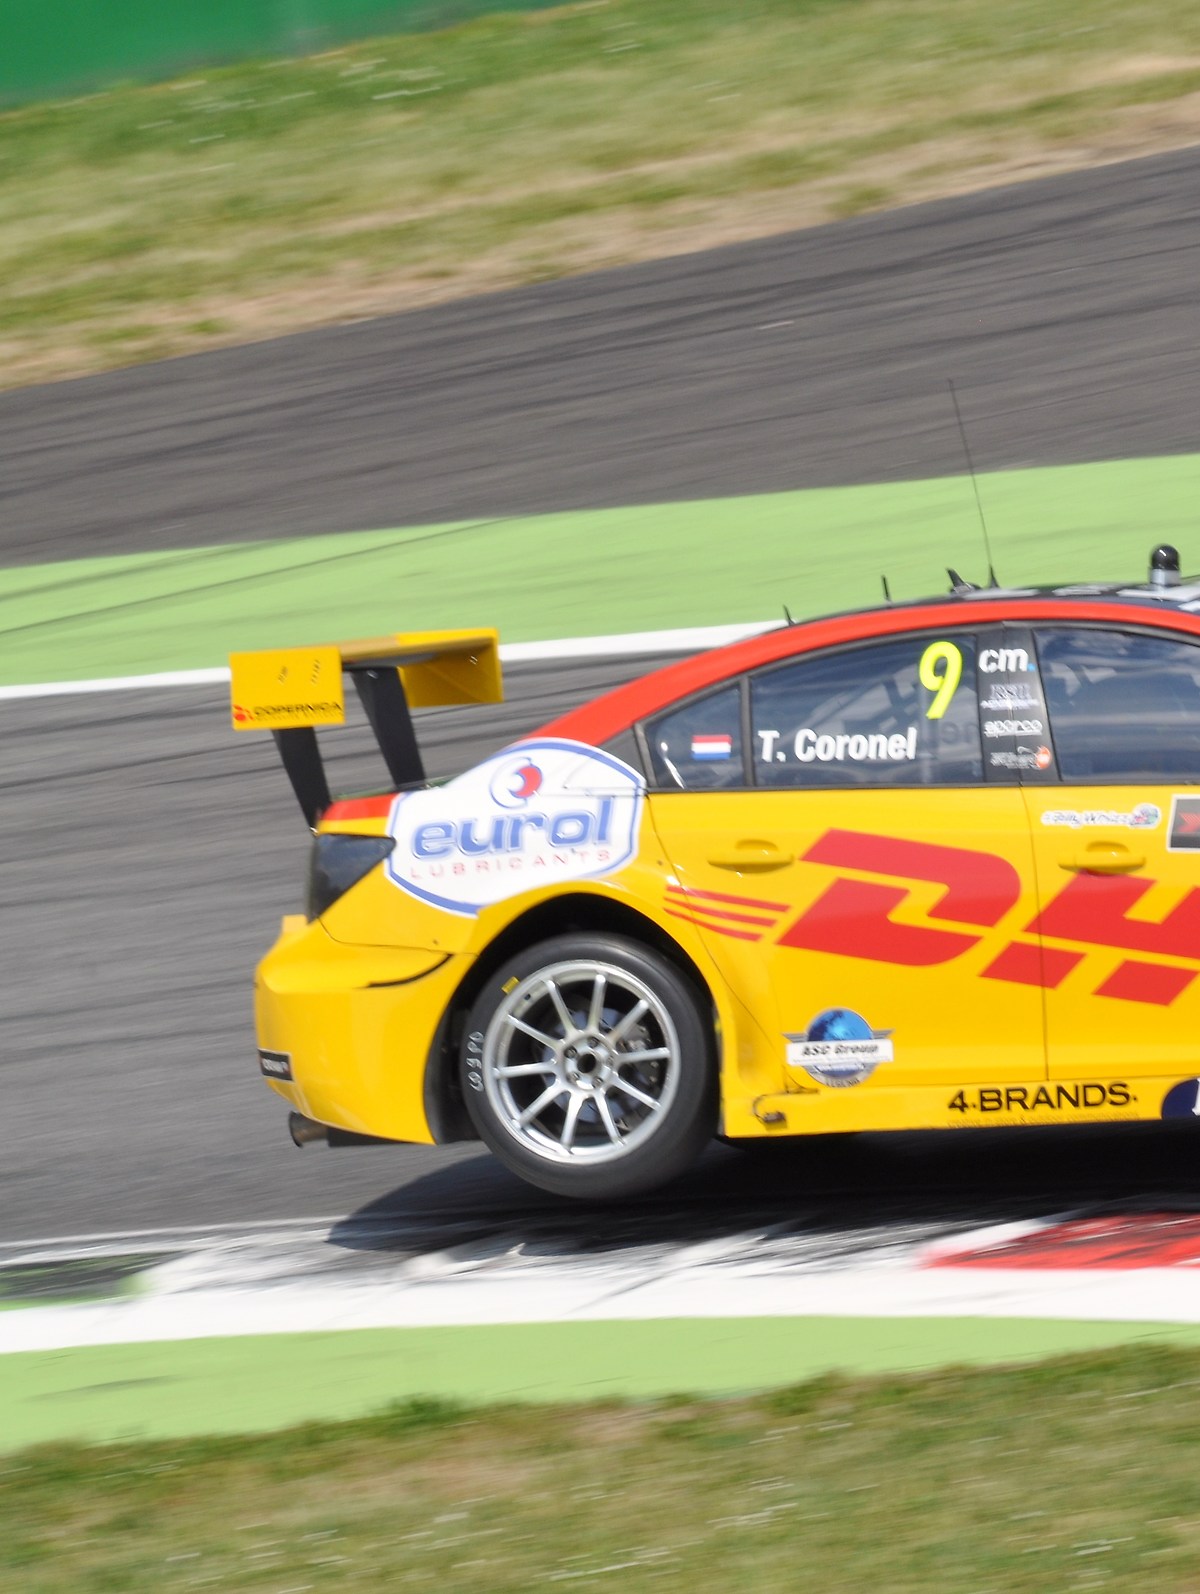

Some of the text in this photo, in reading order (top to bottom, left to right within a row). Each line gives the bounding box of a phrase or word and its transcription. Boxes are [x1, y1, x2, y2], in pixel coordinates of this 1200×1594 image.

[919, 641, 963, 719] 9
[758, 727, 917, 763] T. Coronel
[411, 795, 614, 861] eurol
[409, 850, 611, 880] LUBRICANTS
